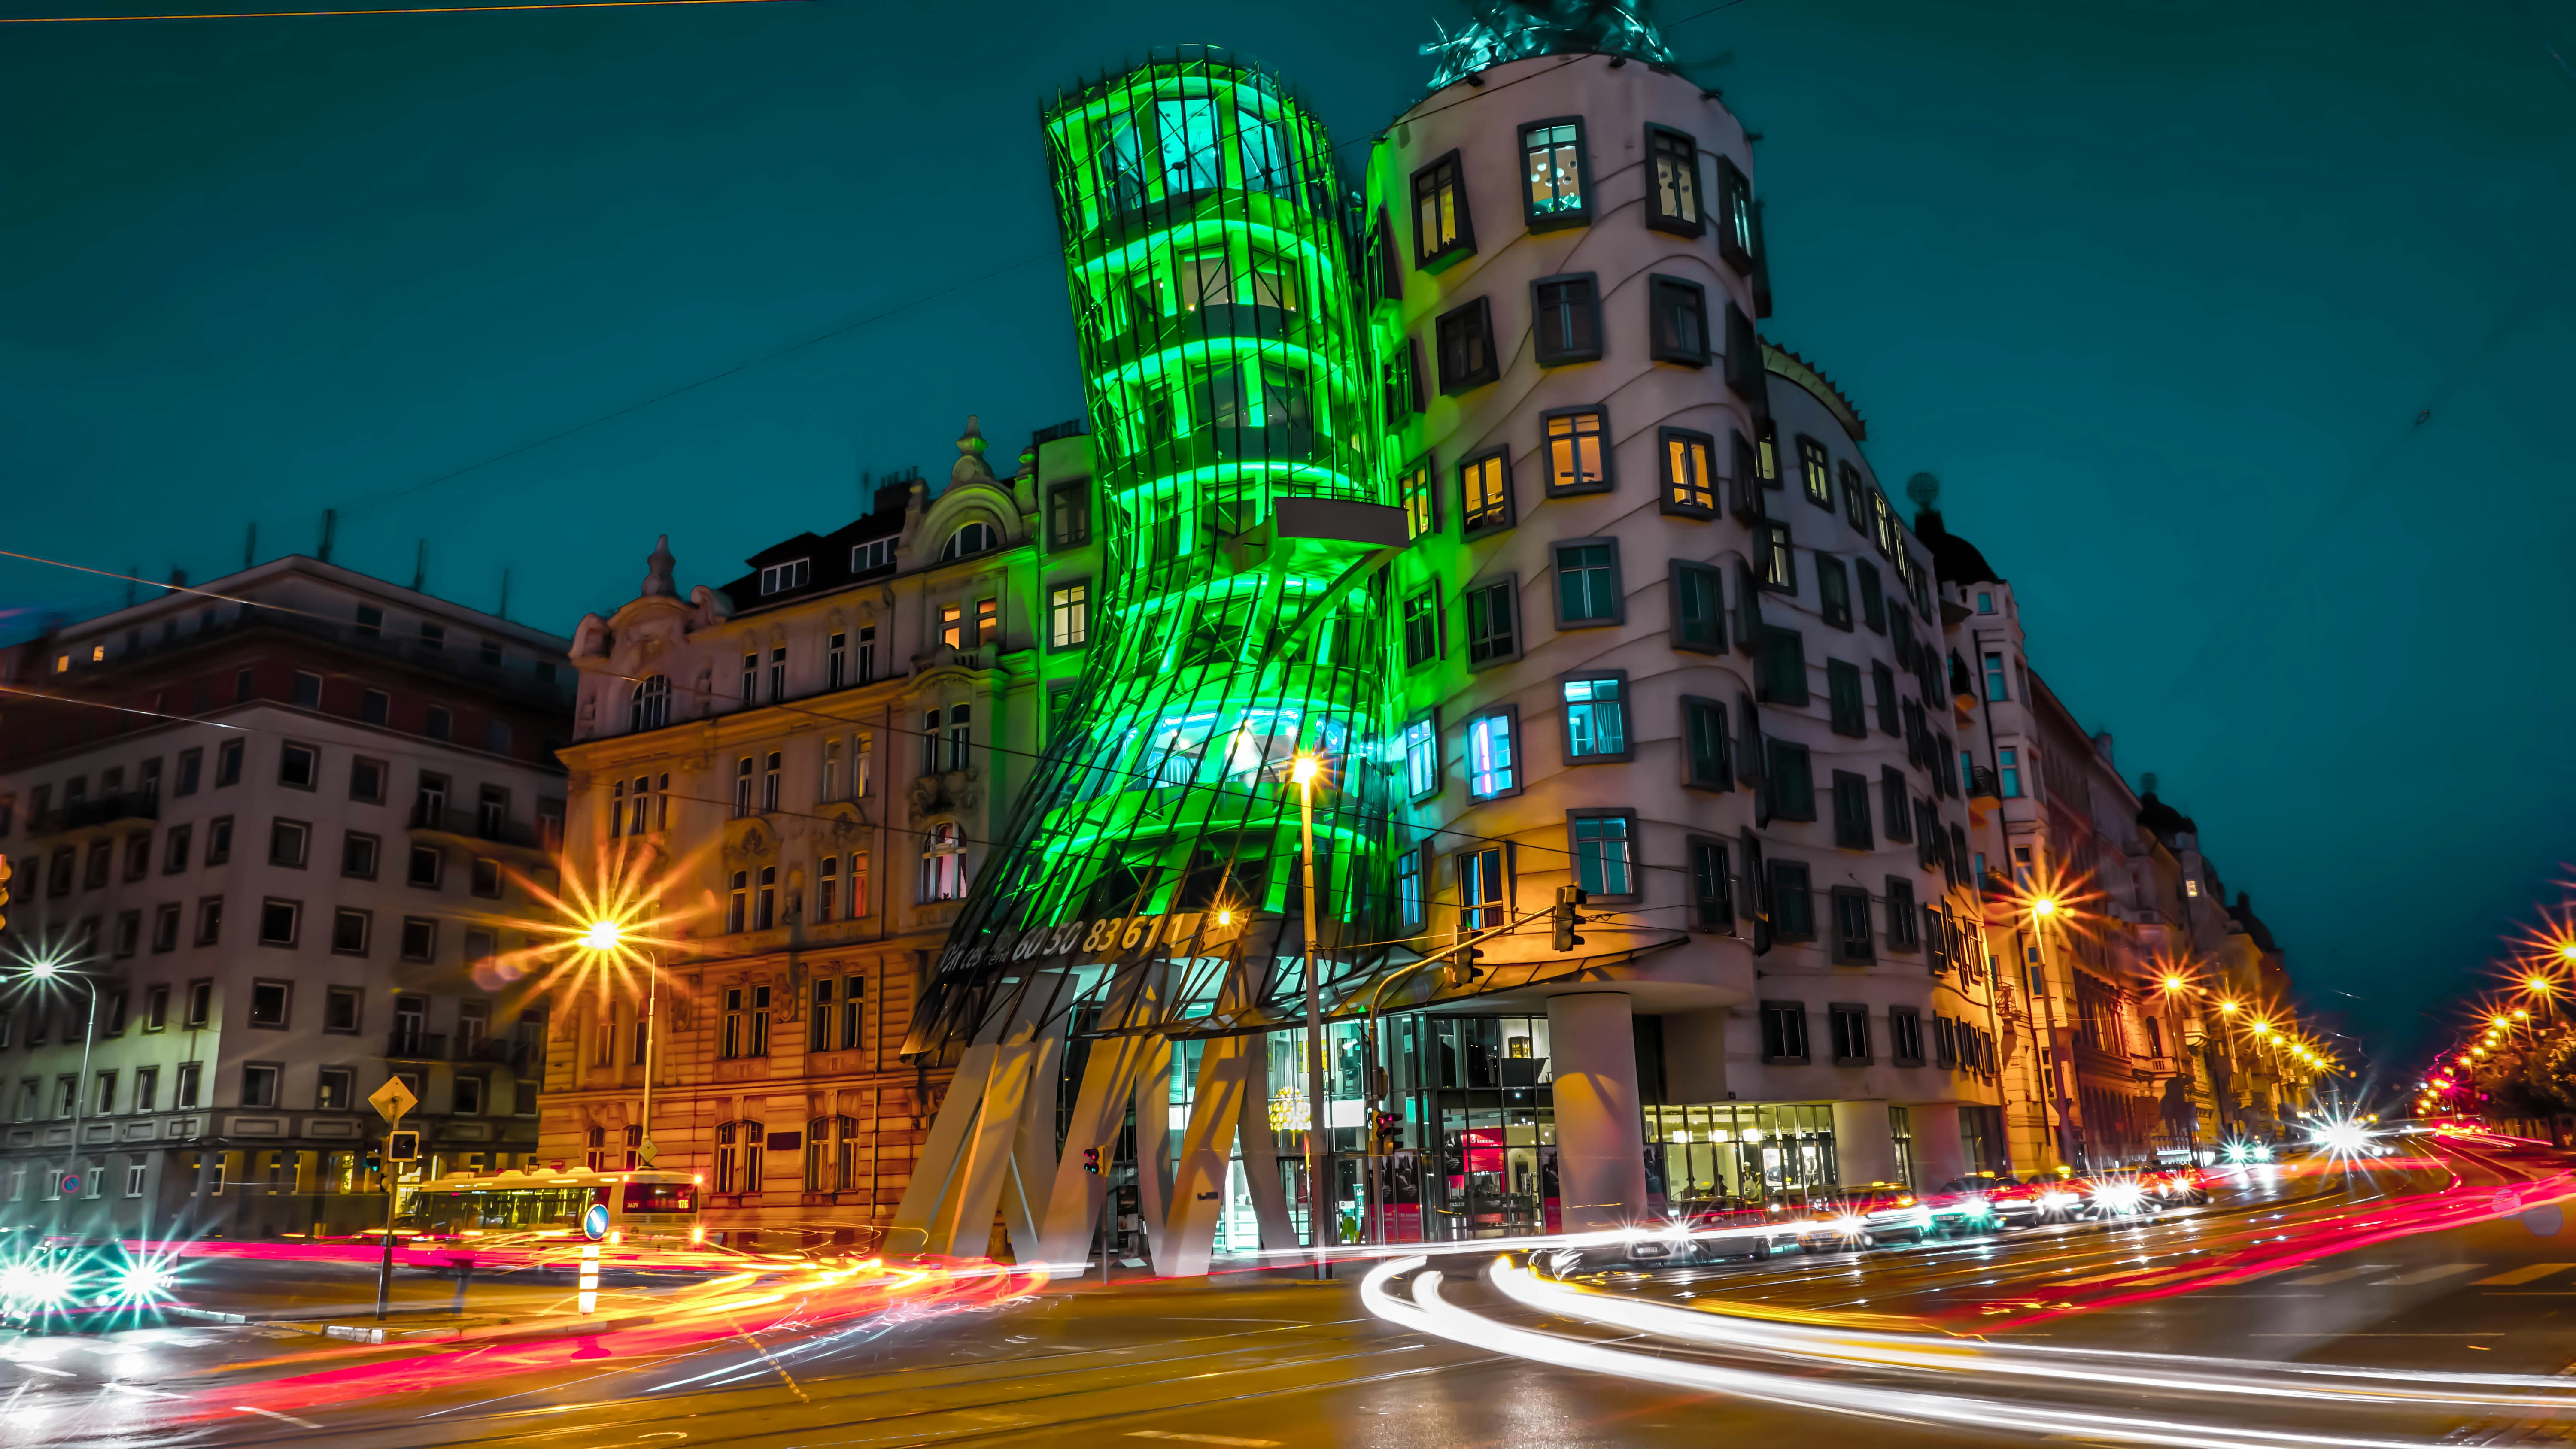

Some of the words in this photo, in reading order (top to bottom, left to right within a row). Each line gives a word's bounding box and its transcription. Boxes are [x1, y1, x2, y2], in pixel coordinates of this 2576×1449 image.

[1012, 926, 1048, 961] 60
[1082, 917, 1122, 952] 83
[678, 1199, 689, 1209] 176
